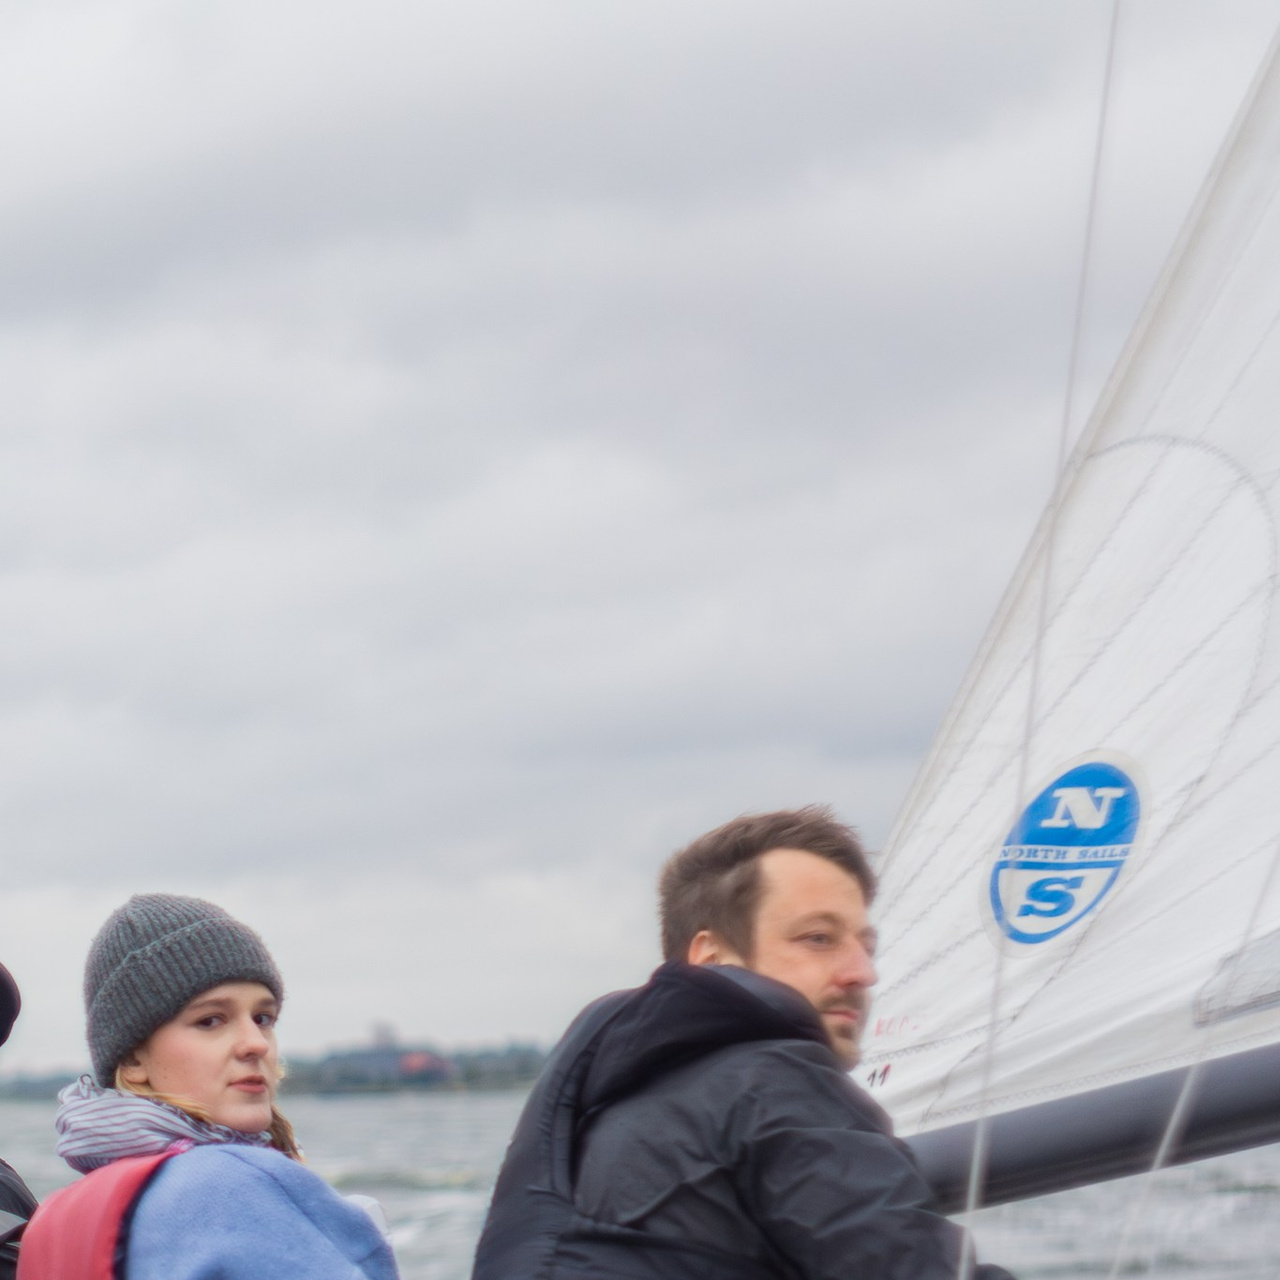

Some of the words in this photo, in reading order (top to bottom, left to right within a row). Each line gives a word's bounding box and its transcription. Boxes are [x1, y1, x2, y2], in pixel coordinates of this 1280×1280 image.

[1040, 786, 1126, 829] N
[999, 847, 1067, 860] NORTH
[1077, 846, 1130, 860] SAILS
[1016, 875, 1085, 918] S
